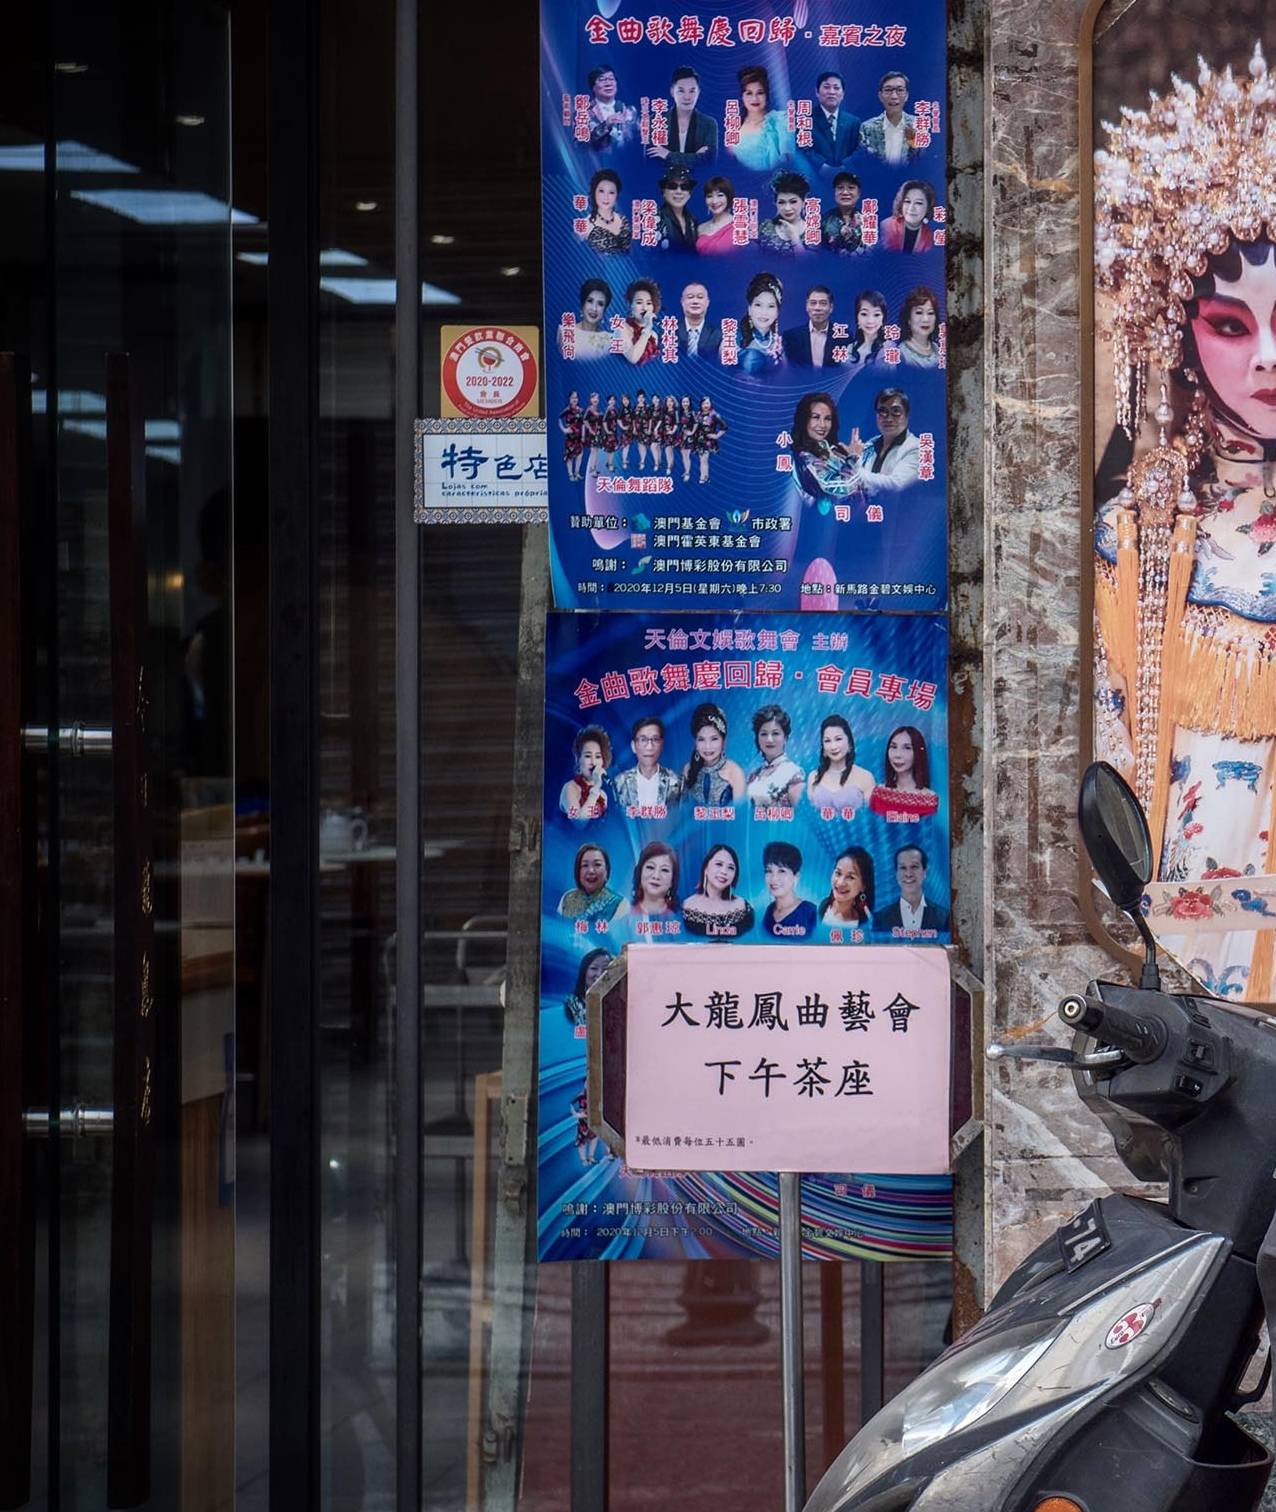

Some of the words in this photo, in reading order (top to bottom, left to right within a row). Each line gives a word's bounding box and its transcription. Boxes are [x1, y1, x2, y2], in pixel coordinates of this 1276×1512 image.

[575, 94, 590, 143] 鄭岳鳴
[651, 97, 668, 146] 李永權
[796, 99, 814, 148] 周和根
[914, 99, 931, 148] 李群勝
[640, 198, 658, 246] 梁偉成
[732, 197, 750, 246] 張雪慧
[610, 313, 625, 354] 女王
[832, 322, 849, 362] 江林
[466, 376, 514, 387] 2020-2022
[441, 443, 548, 480] 特色店
[776, 431, 793, 473] 小鳳
[596, 476, 674, 494] 天倫舞蹈隊
[653, 516, 721, 531] 澳門基金會
[751, 517, 792, 531] 市政署
[834, 505, 884, 523] 司儀
[653, 534, 762, 549] 澳門霍英東基金會
[653, 559, 788, 573] 澳門博彩股份有限公司
[643, 628, 801, 652] 天倫文娛歌舞會
[811, 632, 849, 652] 主辦
[705, 923, 737, 936] Linda
[661, 990, 921, 1033] 大龍鳳曲藝會
[704, 1056, 875, 1098] 下午茶座
